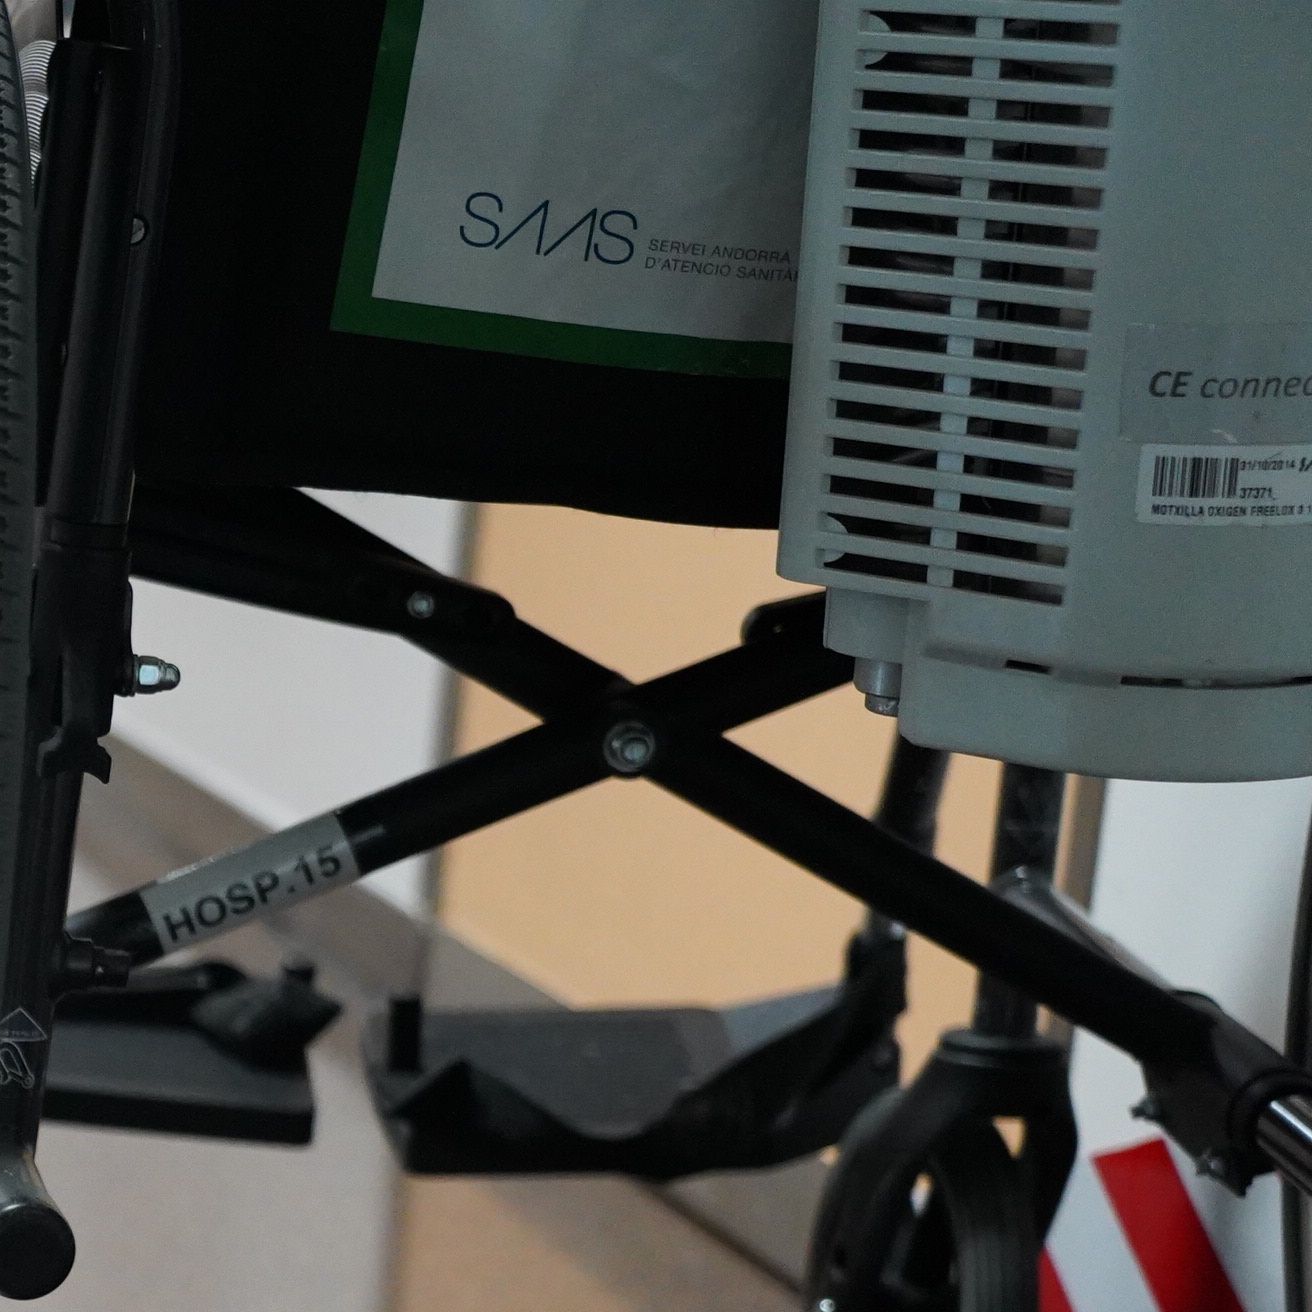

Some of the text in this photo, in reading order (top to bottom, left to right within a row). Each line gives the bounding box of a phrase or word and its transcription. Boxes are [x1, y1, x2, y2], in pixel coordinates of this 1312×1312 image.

[648, 239, 706, 256] SERVEI
[1148, 370, 1193, 398] CE
[1239, 487, 1273, 499] 37371
[1151, 503, 1204, 517] MOTXILLA
[1207, 505, 1247, 517] OXIGEN
[162, 845, 343, 943] HOSP.15
